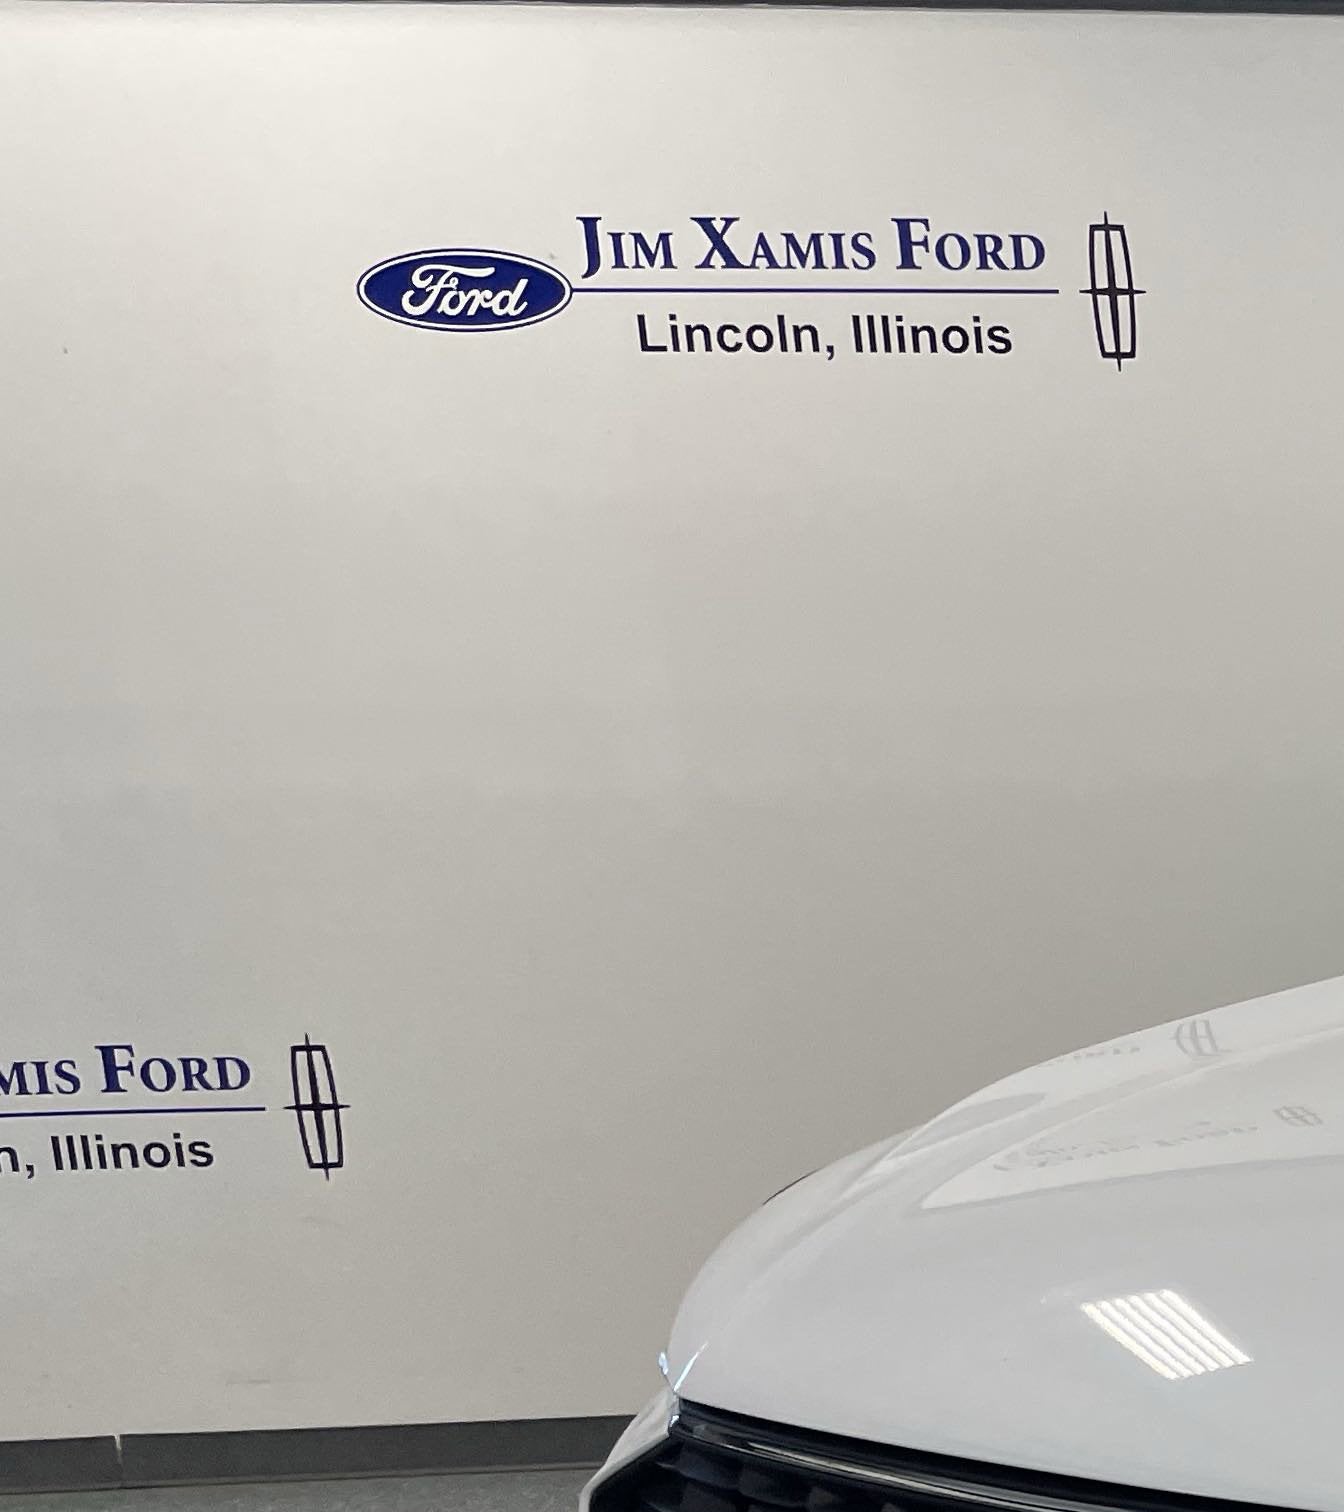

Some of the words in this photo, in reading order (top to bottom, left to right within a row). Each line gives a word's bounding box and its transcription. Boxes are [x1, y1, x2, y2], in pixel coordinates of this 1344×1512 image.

[575, 216, 678, 279] JIM
[689, 216, 876, 271] XAMIS
[890, 217, 1046, 271] FORD
[401, 262, 528, 319] Ford
[637, 313, 835, 361] Lincoln,
[851, 314, 1012, 354] Illinois
[94, 1044, 251, 1095] FORD
[50, 1132, 214, 1171] Illinois
